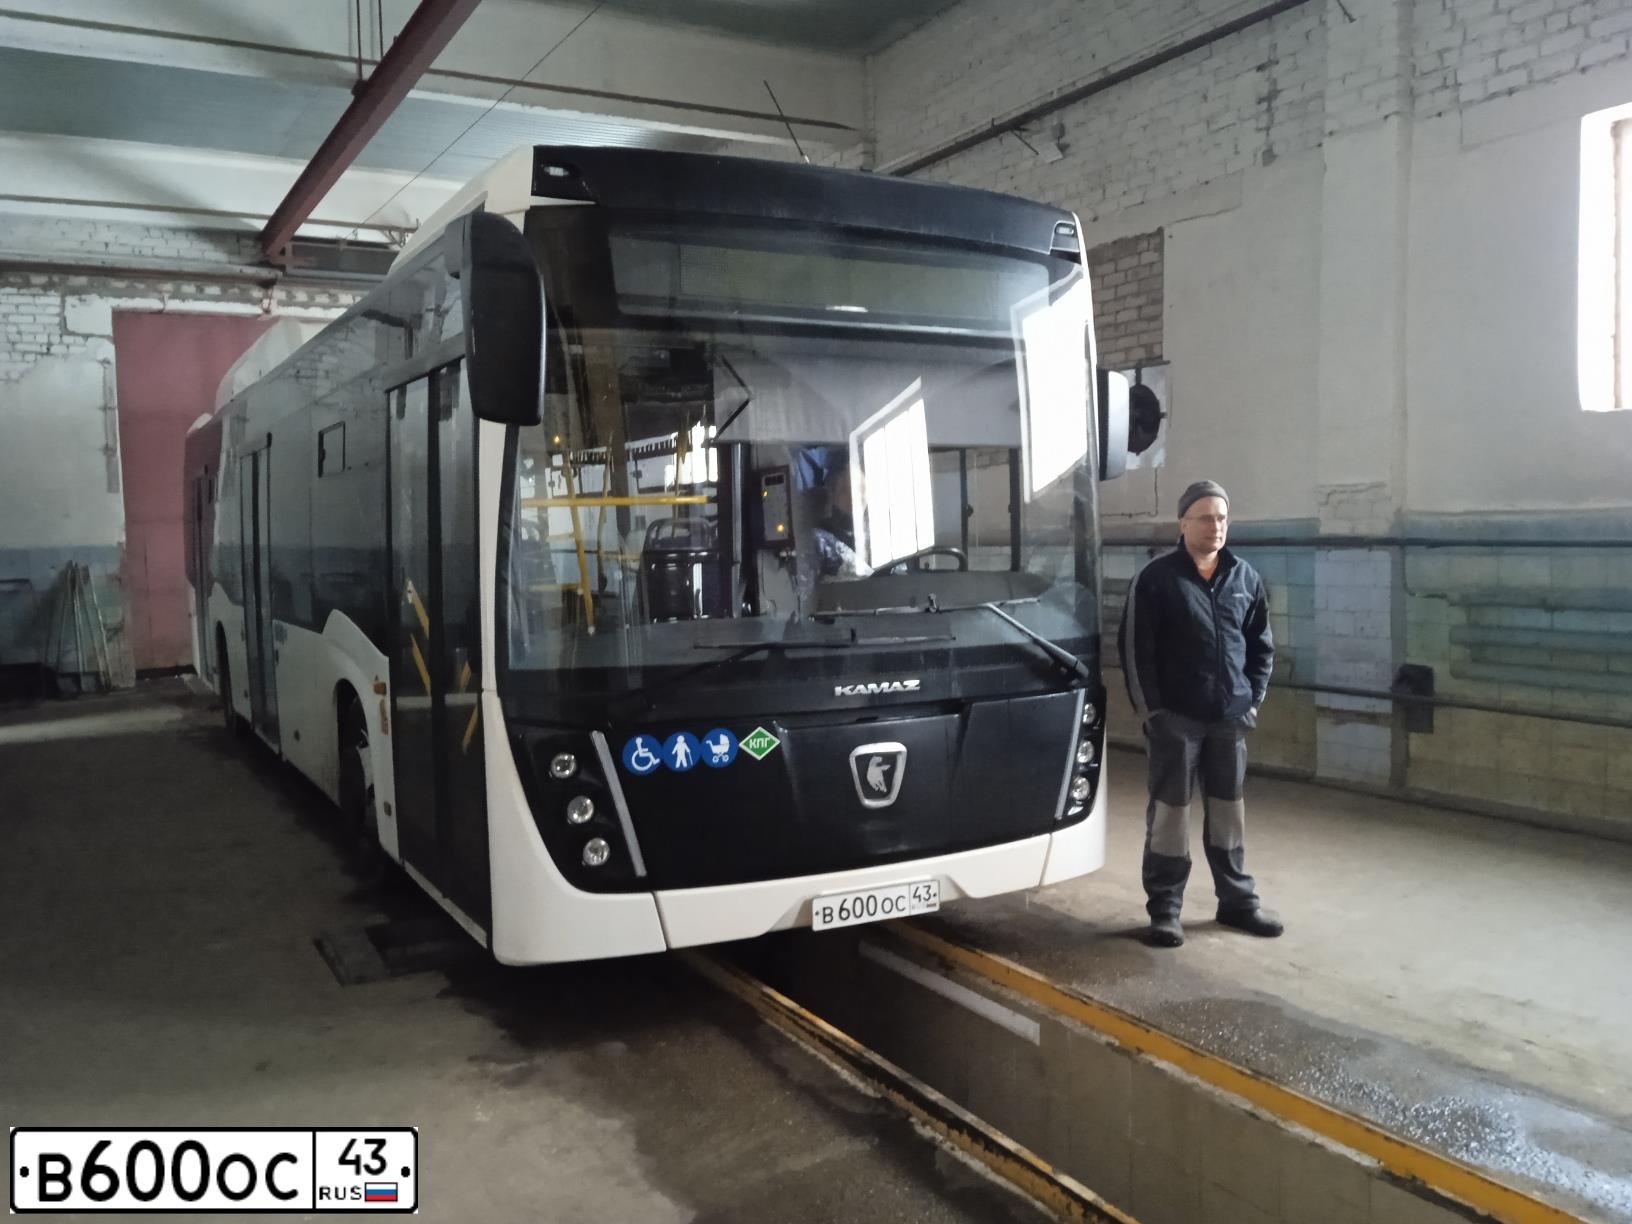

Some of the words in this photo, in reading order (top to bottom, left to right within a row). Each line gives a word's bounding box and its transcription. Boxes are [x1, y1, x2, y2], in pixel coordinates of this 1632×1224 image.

[834, 679, 921, 697] KAMAZ
[749, 737, 770, 749] КПГ
[912, 884, 931, 902] 43
